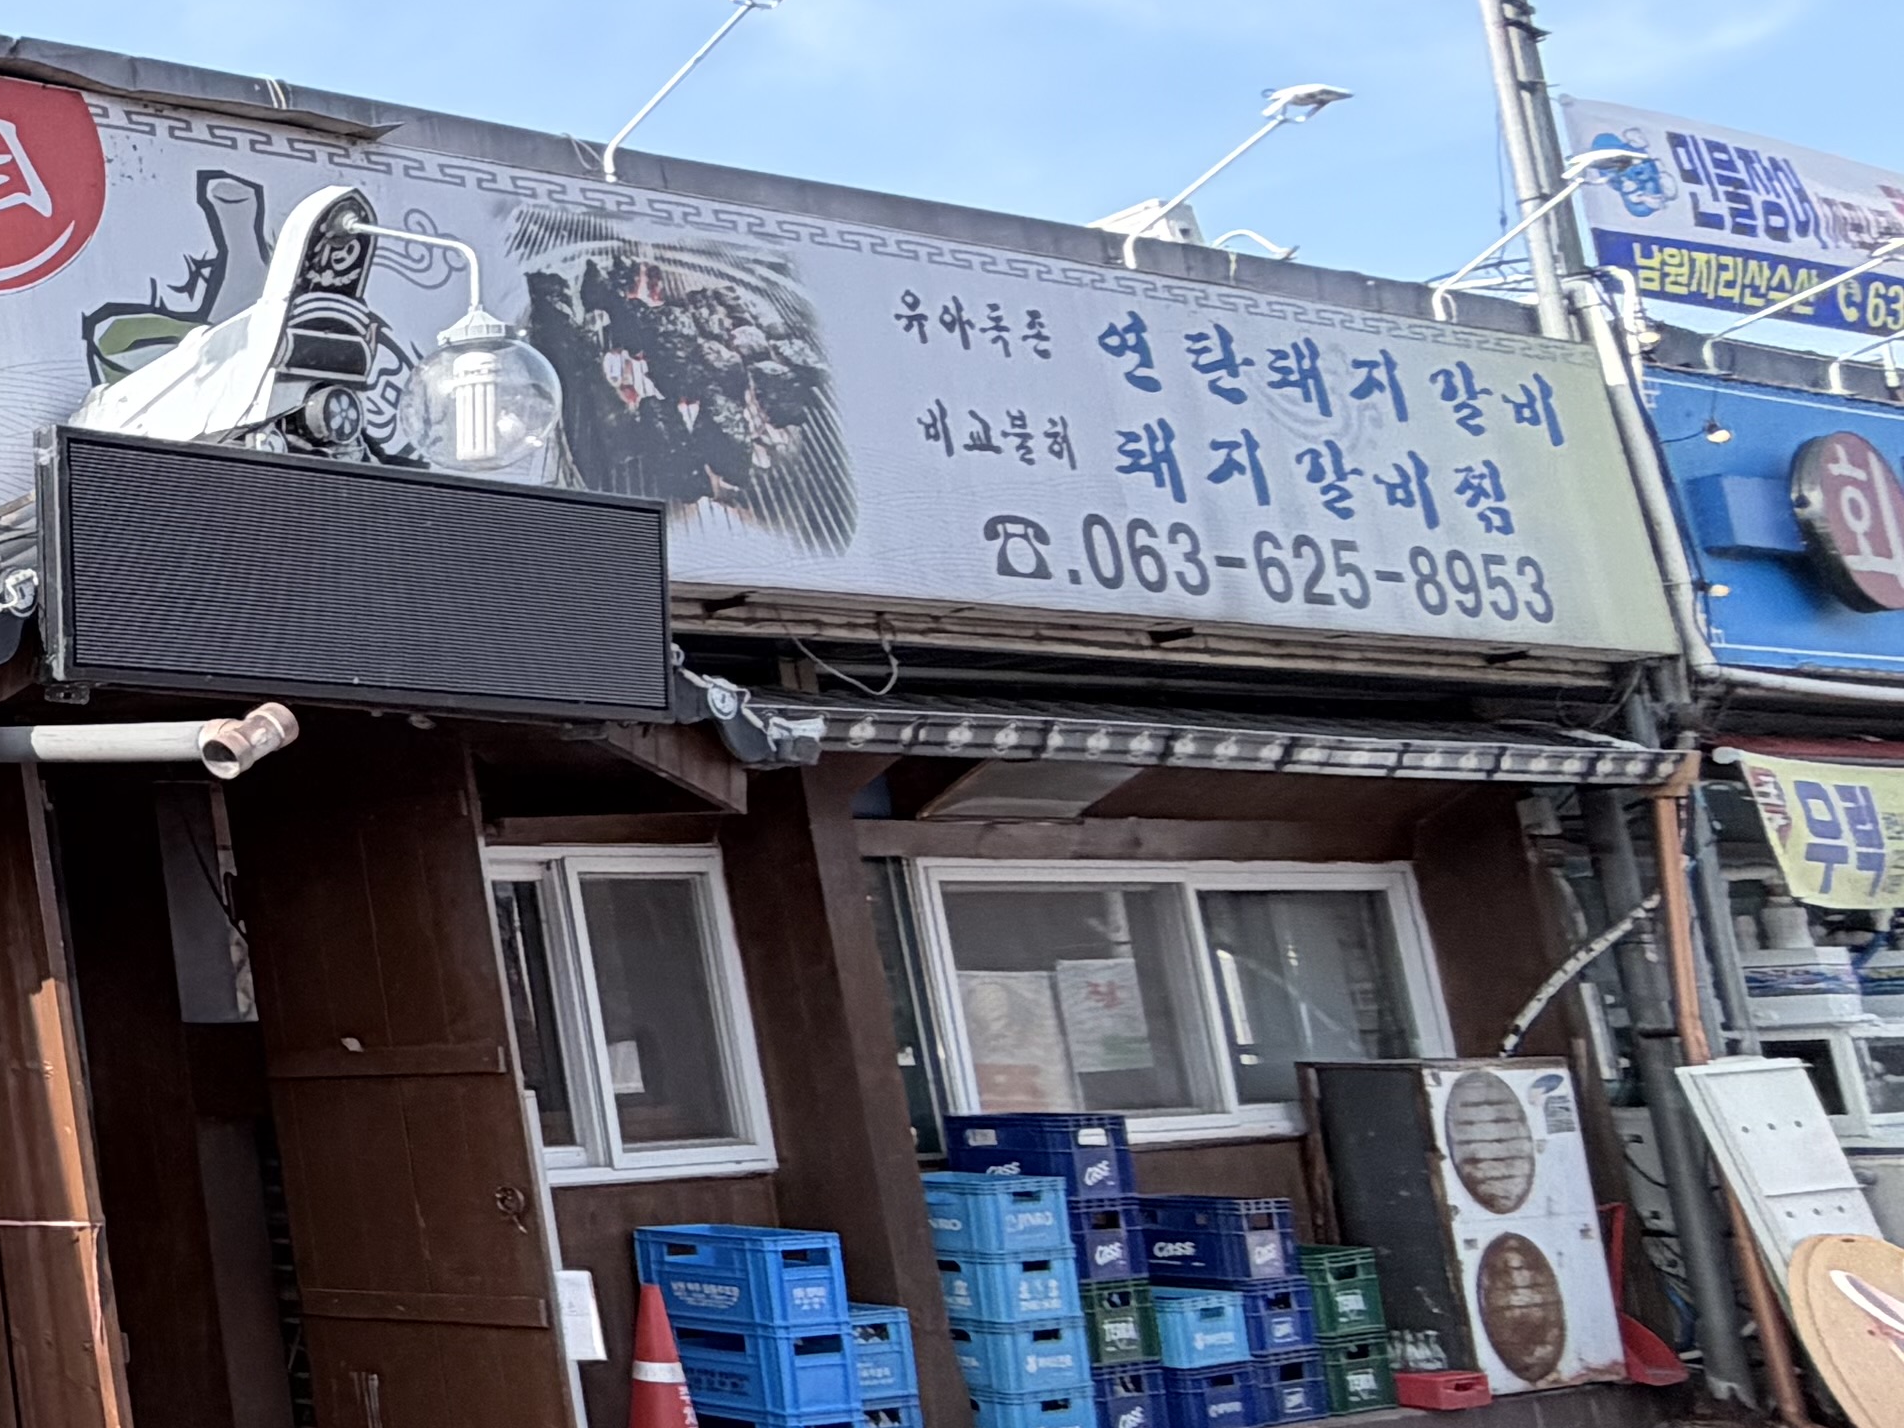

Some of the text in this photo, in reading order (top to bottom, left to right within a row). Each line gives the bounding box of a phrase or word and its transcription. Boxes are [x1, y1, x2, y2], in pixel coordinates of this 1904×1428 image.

[894, 288, 1565, 447] 유아독존 연탄돼지갈비
[916, 398, 1516, 536] 비교불허 돼지갈비찜
[1152, 1241, 1197, 1258] Cass
